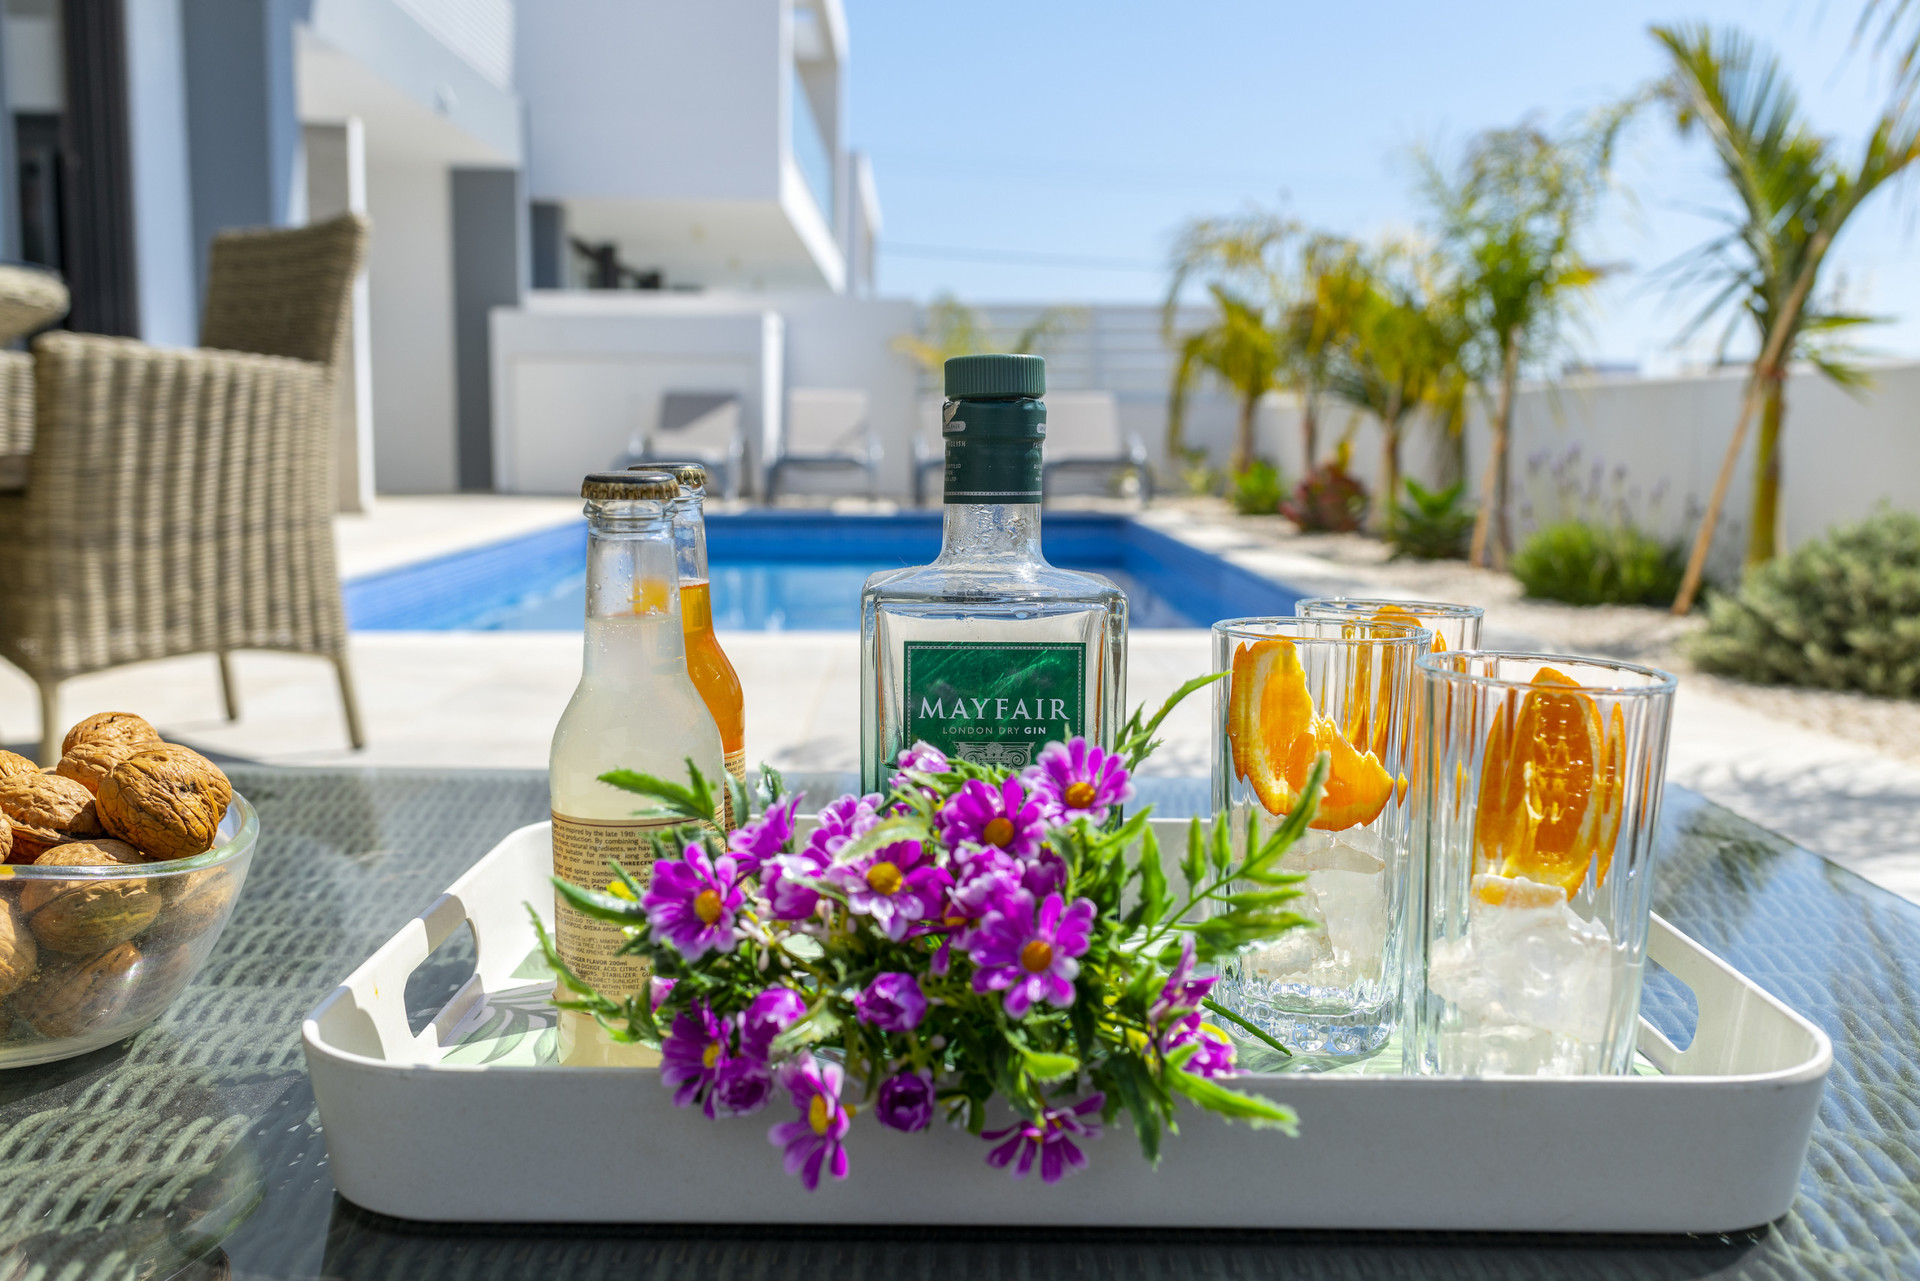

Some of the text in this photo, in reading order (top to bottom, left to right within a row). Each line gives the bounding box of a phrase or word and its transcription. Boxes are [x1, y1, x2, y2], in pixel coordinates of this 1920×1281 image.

[918, 697, 1071, 721] MAYFAIR
[942, 726, 1046, 735] LONDON DRY GIN
